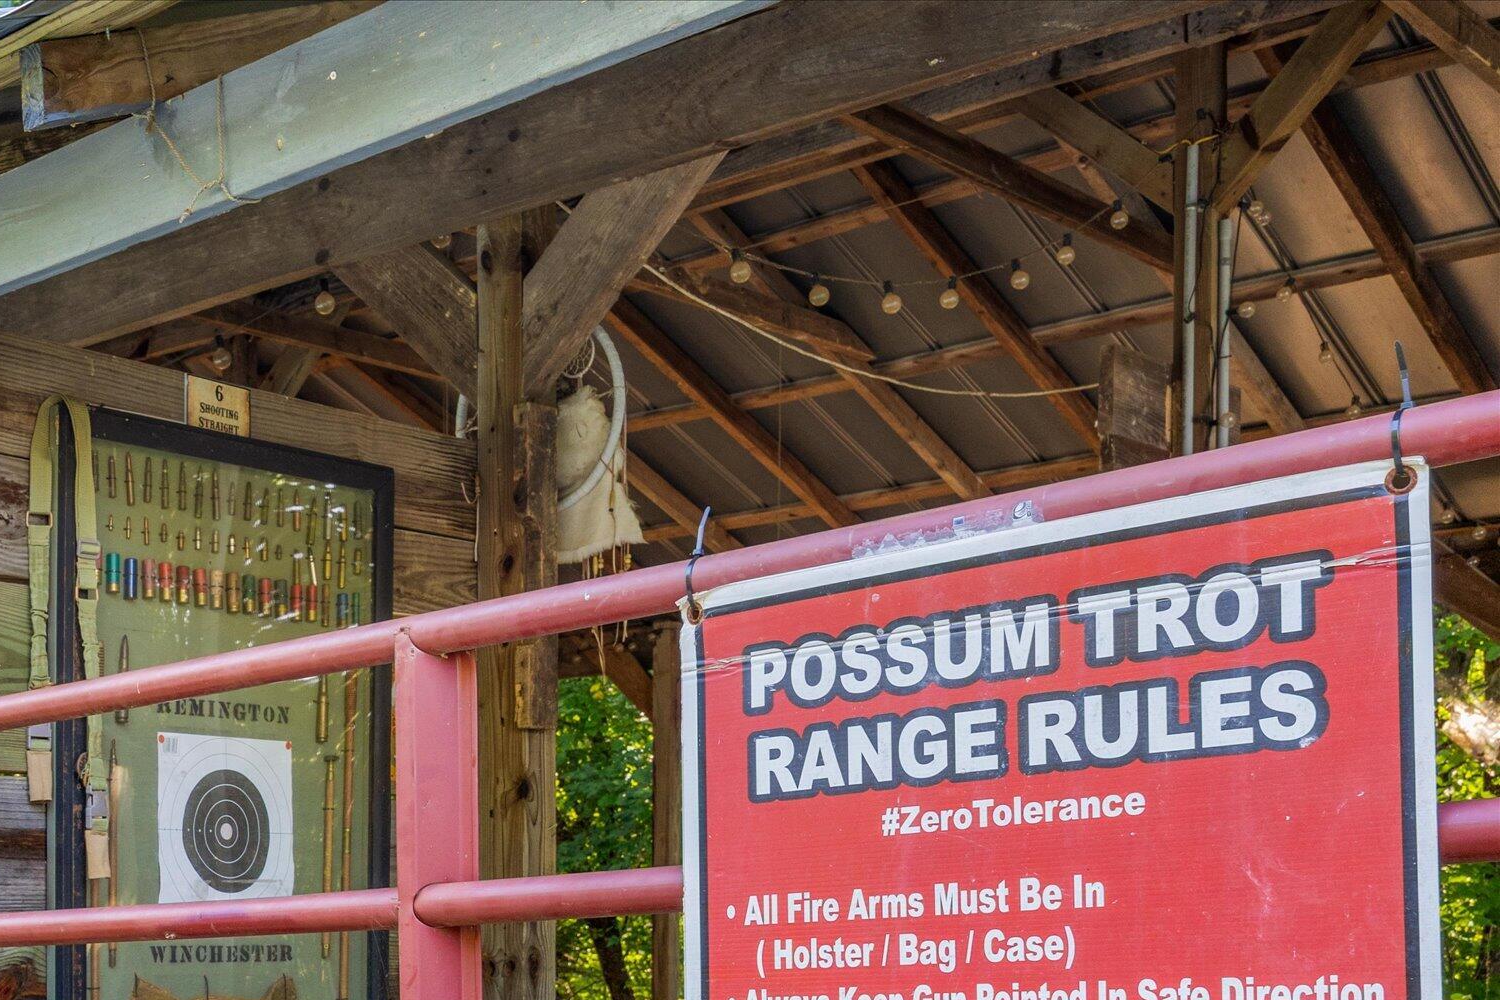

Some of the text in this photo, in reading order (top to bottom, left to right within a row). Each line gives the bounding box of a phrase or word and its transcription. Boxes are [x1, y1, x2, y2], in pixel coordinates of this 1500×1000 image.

[200, 402, 239, 420] SHOOTING
[215, 385, 224, 401] 6
[199, 416, 240, 435] STRAIGHT
[749, 558, 1323, 709] POSSUM TROT
[156, 698, 290, 724] REMINGTON
[754, 668, 1318, 796] RANGE RULES
[881, 791, 1147, 837] #ZeroTolerance
[744, 874, 1105, 926] All Fire Arms Must Be In
[150, 944, 294, 963] WINCHESTER
[881, 933, 891, 967] /
[899, 932, 957, 973] Bag
[965, 929, 975, 964] /
[983, 925, 1076, 970] Case)
